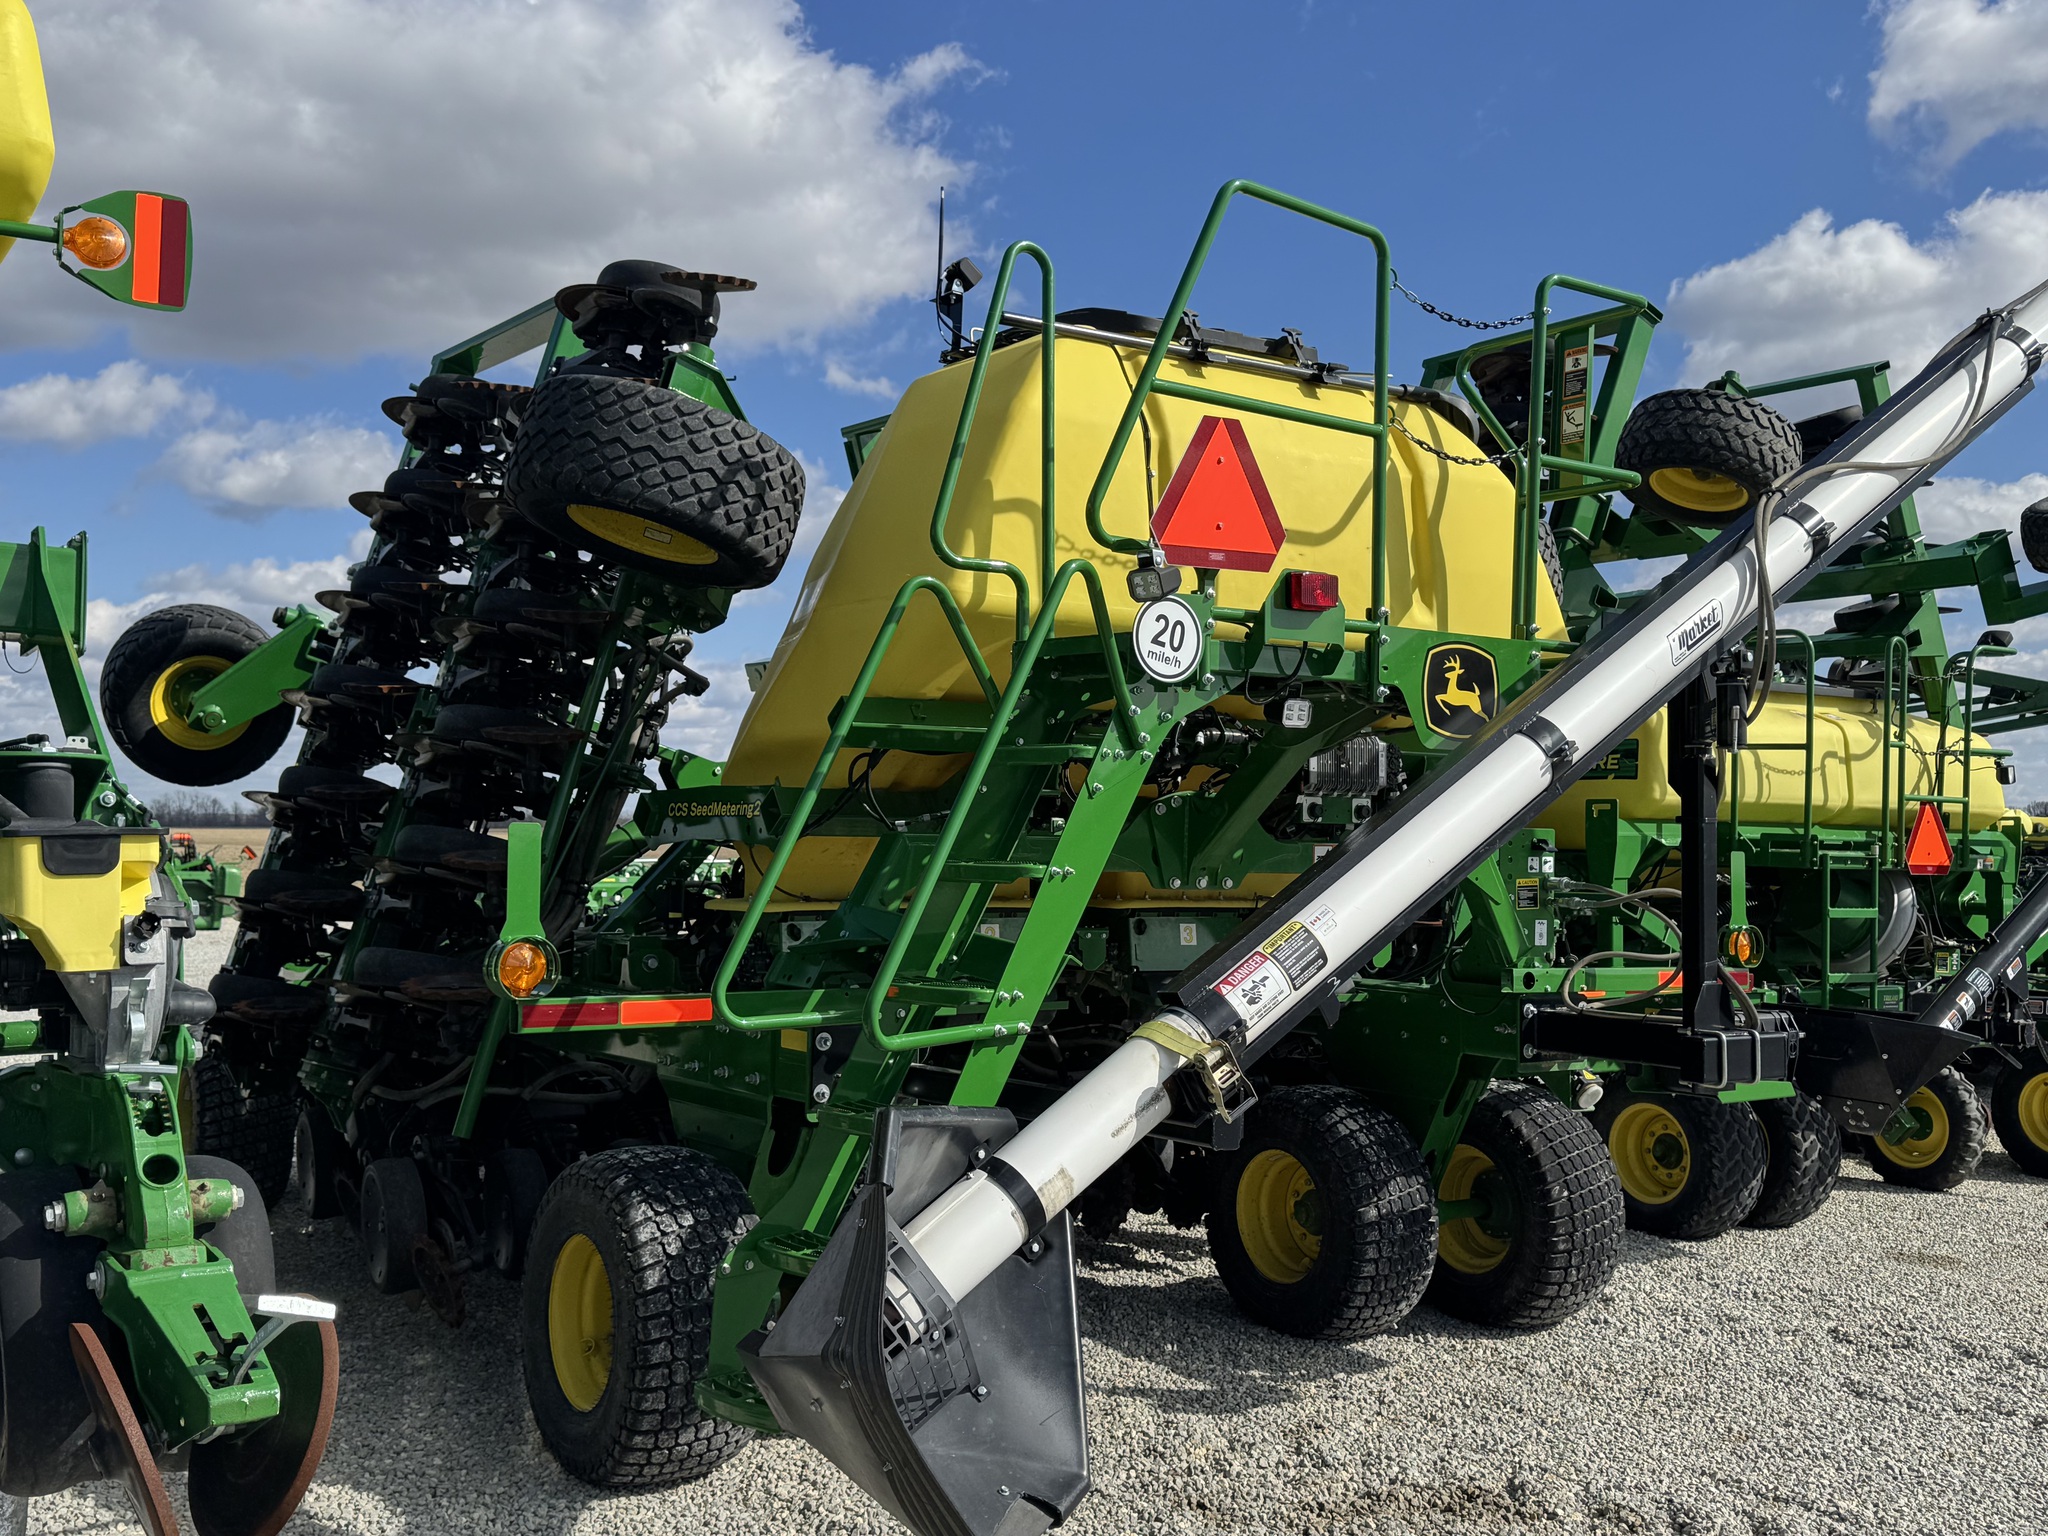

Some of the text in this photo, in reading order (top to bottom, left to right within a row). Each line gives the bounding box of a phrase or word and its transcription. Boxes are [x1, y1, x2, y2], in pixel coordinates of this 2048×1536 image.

[1150, 613, 1186, 653] 20
[1678, 605, 1720, 651] Market
[1147, 649, 1182, 669] mile/h
[668, 800, 762, 819] CCS SeedMetering2
[1183, 925, 1194, 944] 3
[1227, 954, 1265, 986] DANGER
